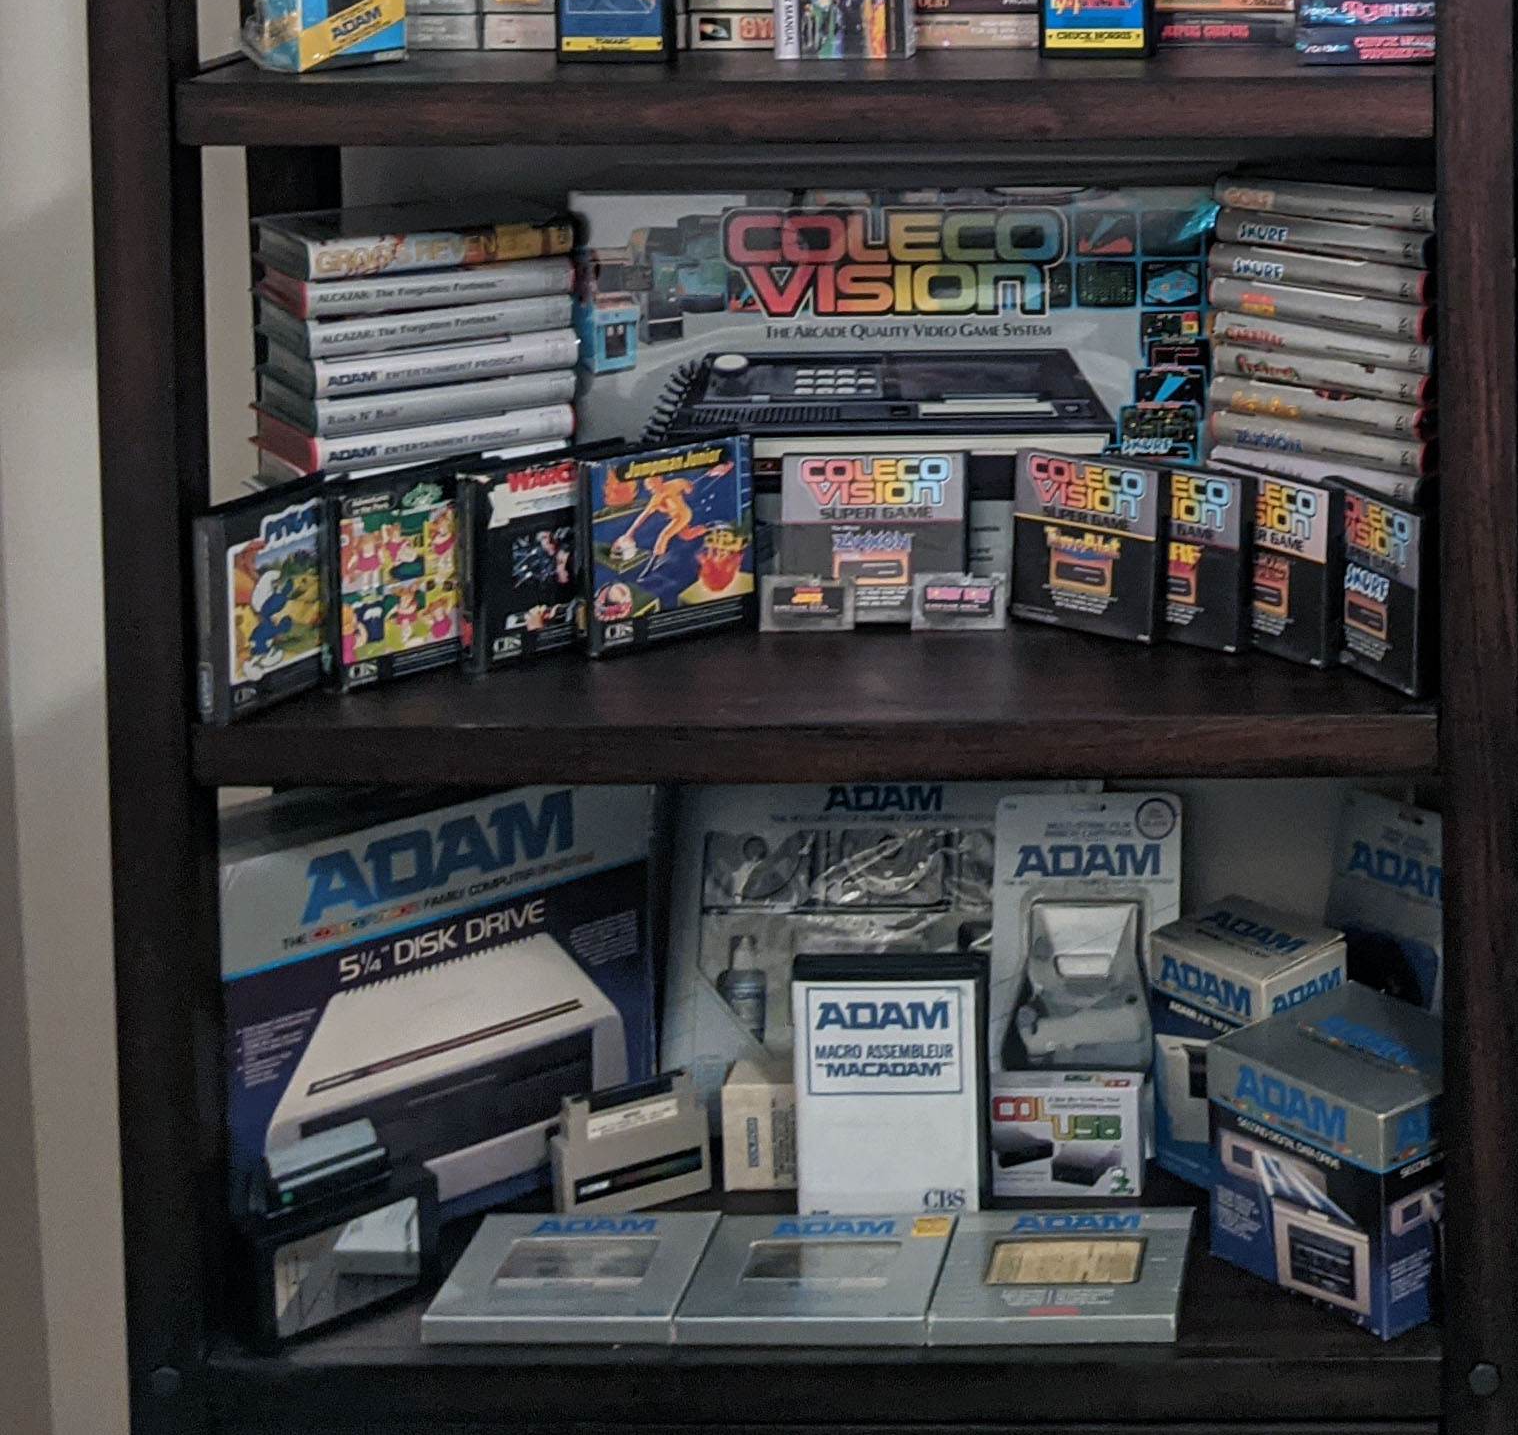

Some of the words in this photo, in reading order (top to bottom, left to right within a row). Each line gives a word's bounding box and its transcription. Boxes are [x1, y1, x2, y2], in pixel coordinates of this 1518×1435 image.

[331, 8, 382, 40] ADAM
[783, 2, 794, 46] MANUAL
[726, 209, 1065, 263] COLECO
[743, 263, 1047, 316] VISION
[766, 326, 791, 338] THE
[794, 325, 846, 339] ARCADE
[850, 325, 909, 339] QUALITY
[913, 325, 957, 339] VIDEO
[961, 324, 998, 338] GAME
[1002, 324, 1051, 338] SYSTEM
[328, 372, 378, 388] ADAM
[801, 458, 952, 482] COLECO
[819, 482, 942, 506] VISION
[820, 507, 876, 520] SUPER
[883, 506, 933, 518] GAME
[824, 785, 943, 811] ADAM
[302, 790, 574, 925] ADAM
[1014, 844, 1161, 876] ADAM
[394, 925, 457, 965] DISK
[465, 899, 546, 941] DRIVE
[1159, 953, 1251, 1018] ADAM
[815, 1001, 949, 1030] ADAM
[815, 1045, 862, 1060] MACRO
[866, 1043, 952, 1060] ASSEMBLEUR
[1236, 1065, 1346, 1144] ADAM
[924, 1189, 965, 1207] CBS
[533, 1217, 657, 1234] ADAM
[772, 1217, 897, 1238] ADAM
[1011, 1213, 1141, 1232] ADAM
